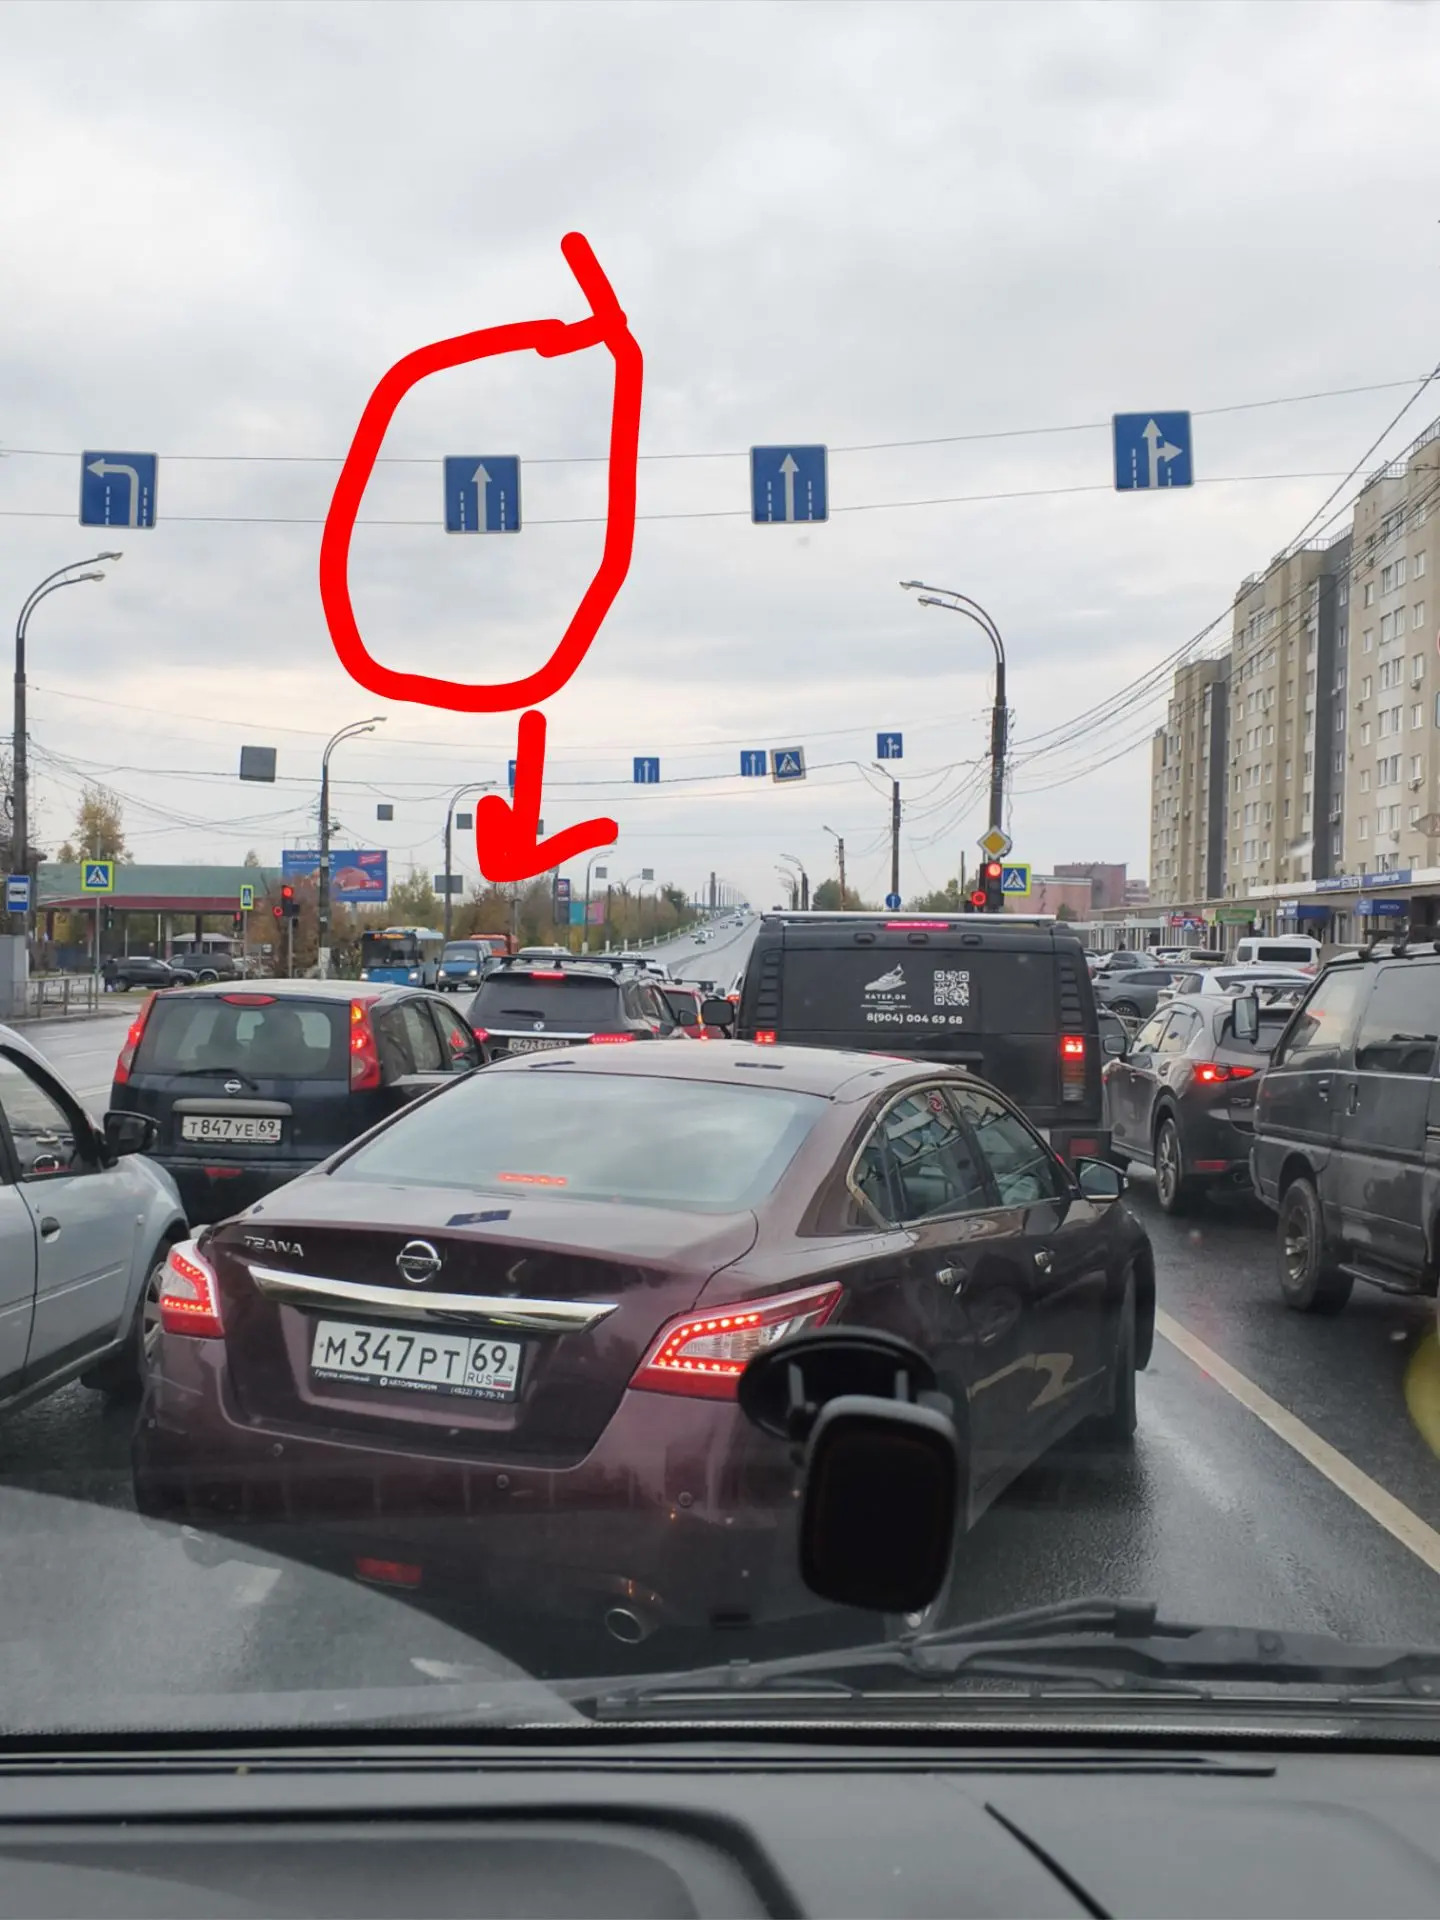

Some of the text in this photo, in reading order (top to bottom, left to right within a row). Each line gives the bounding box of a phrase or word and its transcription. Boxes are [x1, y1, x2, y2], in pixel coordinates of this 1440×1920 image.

[866, 1013, 963, 1024] 8(904) 004 69 68
[190, 1120, 276, 1137] Т847УЕ 69
[244, 1235, 305, 1257] TEANA
[324, 1331, 508, 1379] М347РТ 69
[467, 1371, 493, 1386] RUS
